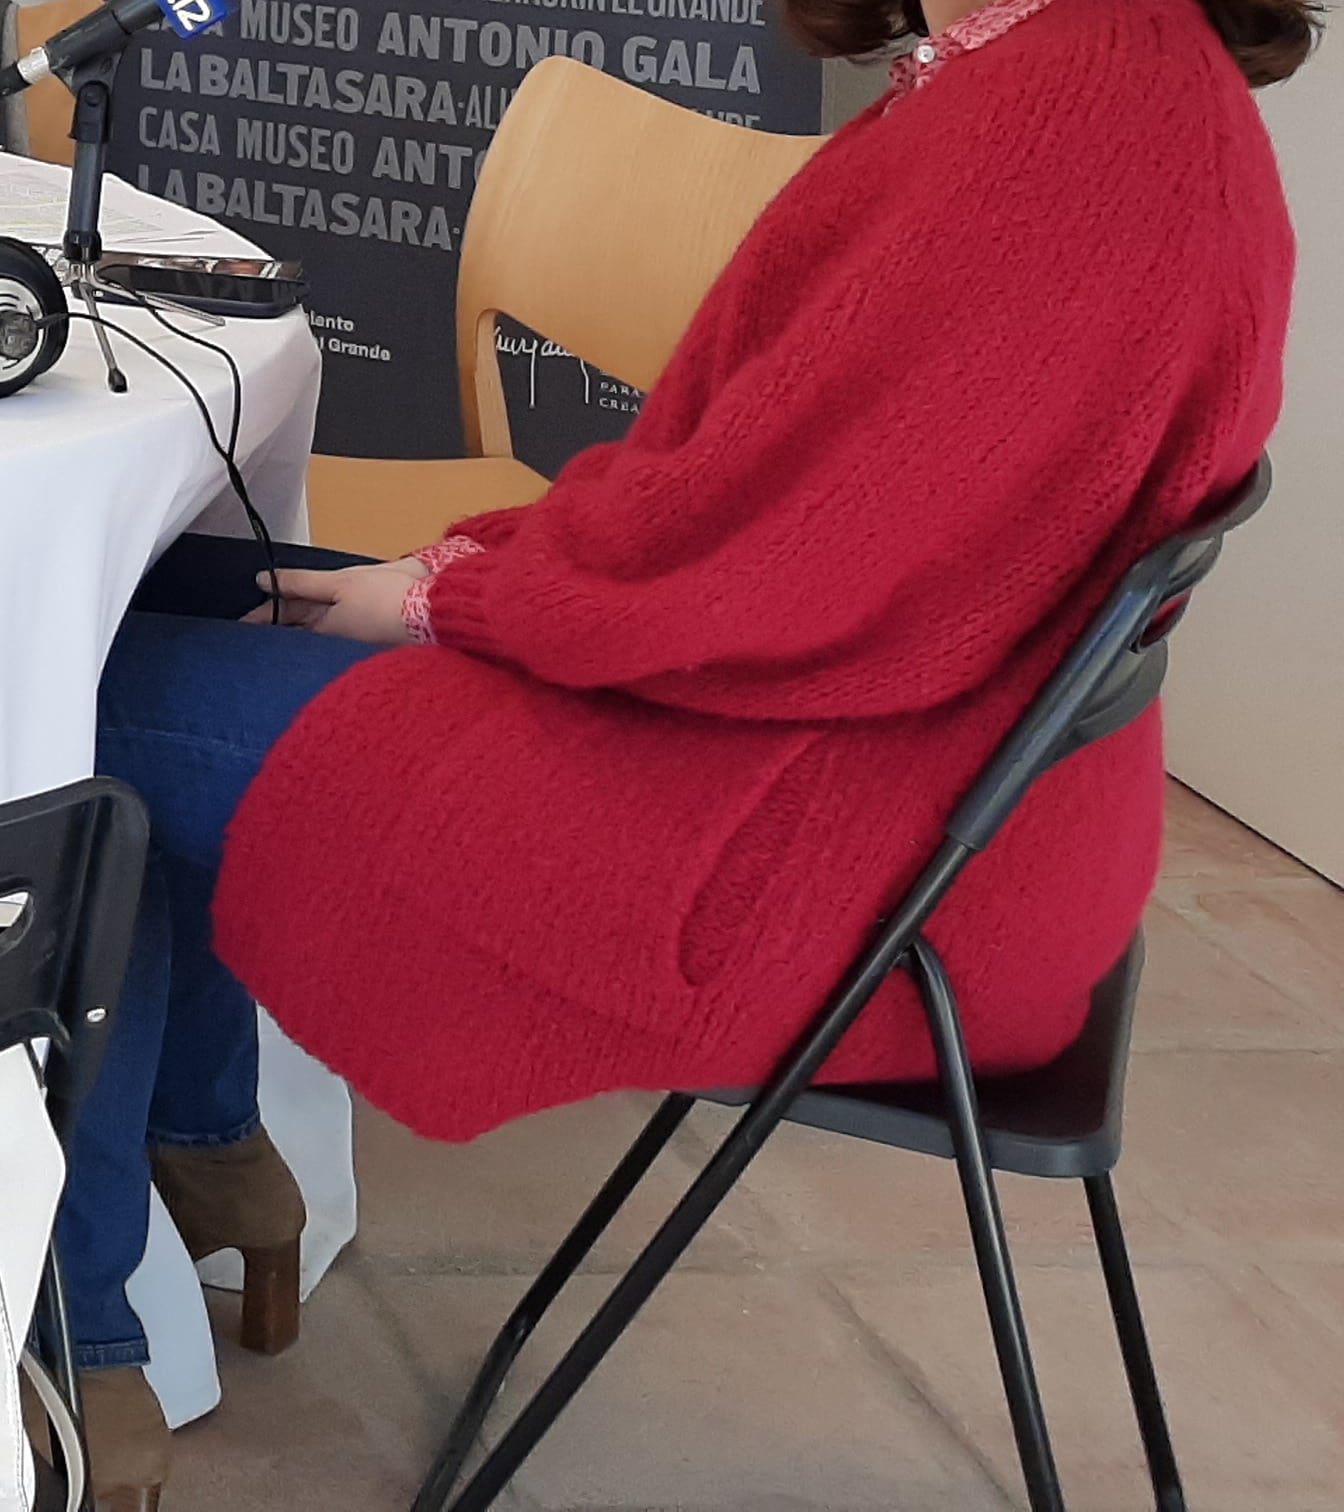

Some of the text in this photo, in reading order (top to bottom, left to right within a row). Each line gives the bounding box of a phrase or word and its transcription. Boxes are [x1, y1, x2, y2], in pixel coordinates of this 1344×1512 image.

[241, 0, 760, 94] MUSEO ANTONIO GALA
[141, 48, 191, 92] LA
[139, 107, 220, 155] CASA
[237, 118, 354, 174] MUSEO
[328, 337, 391, 361] Grande
[599, 397, 641, 416] CREA
